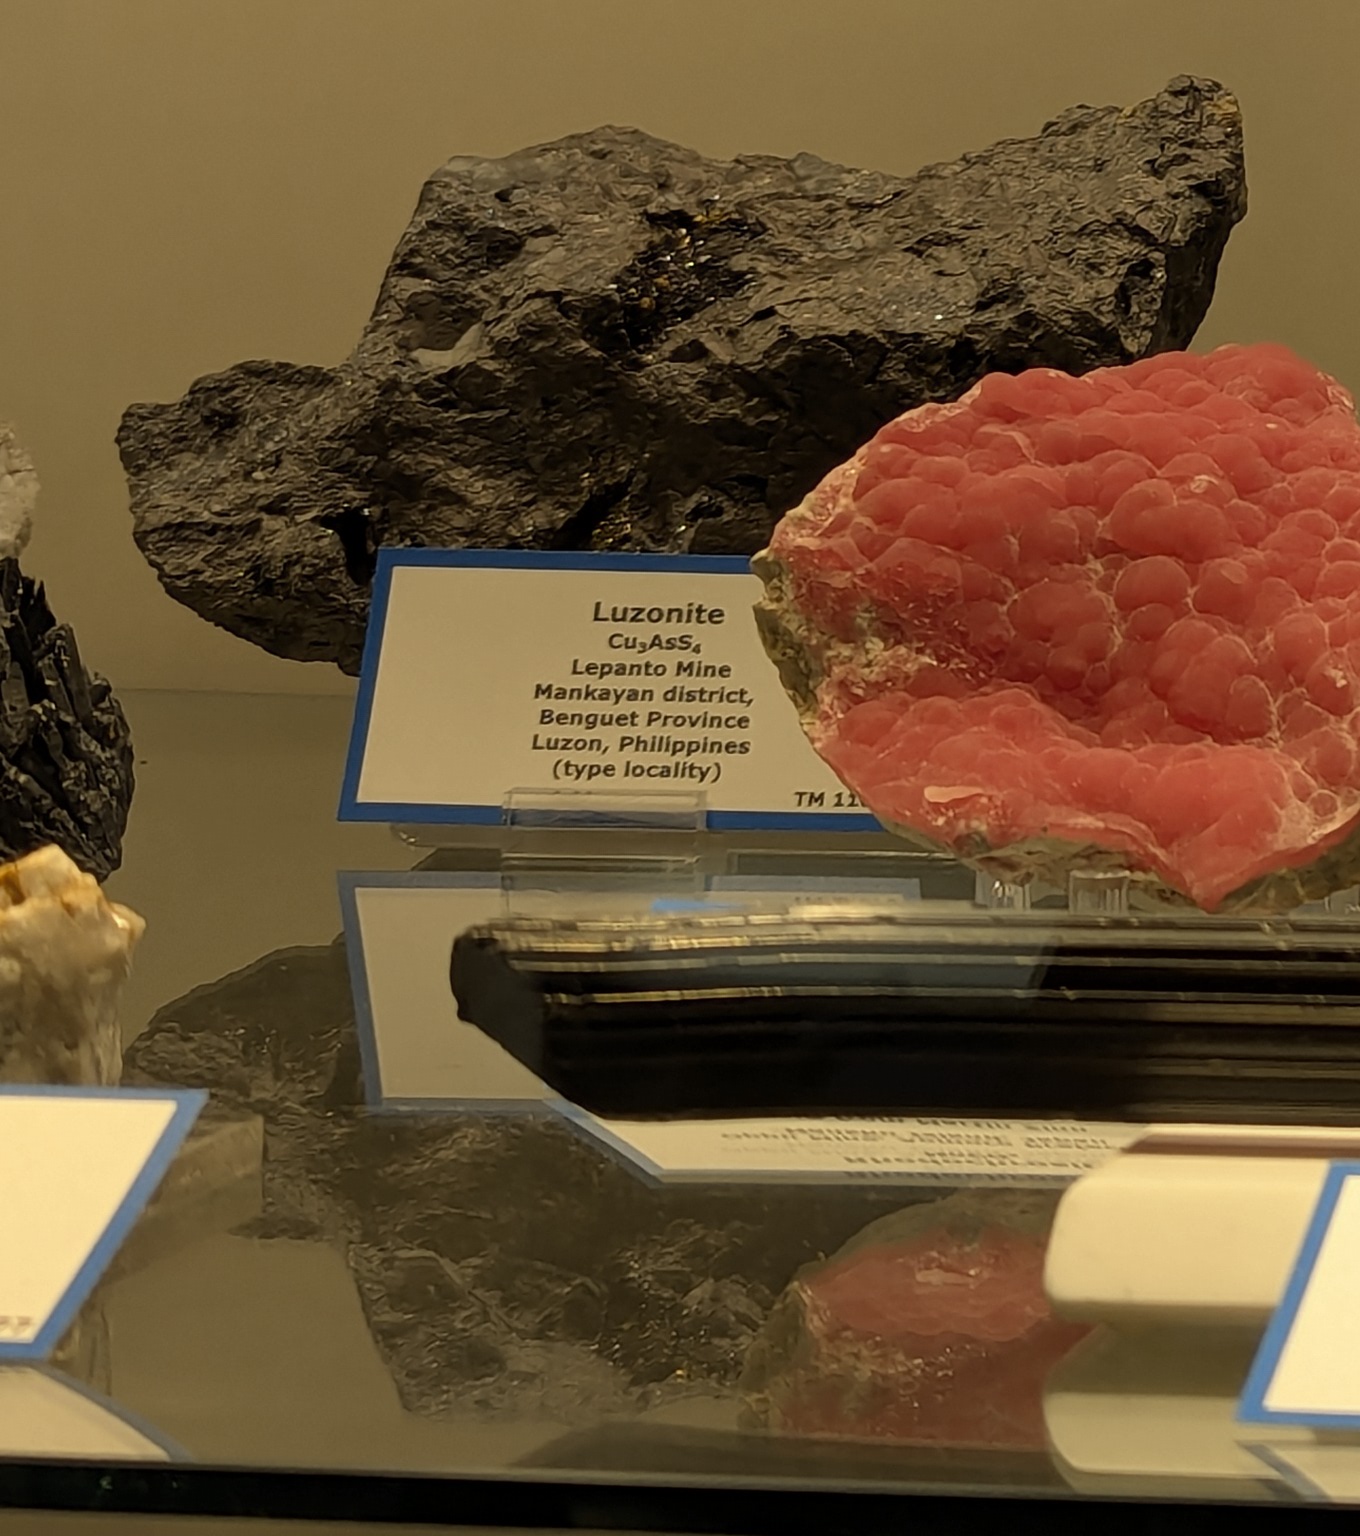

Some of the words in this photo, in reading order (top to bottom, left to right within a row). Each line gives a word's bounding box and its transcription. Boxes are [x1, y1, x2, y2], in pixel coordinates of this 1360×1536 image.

[592, 601, 725, 625] Luzonite
[571, 659, 667, 679] Lepanto
[675, 661, 732, 678] Mine
[533, 683, 654, 705] Mankayan
[662, 685, 755, 707] district,
[539, 708, 639, 730] Benguet
[646, 711, 751, 729] Province
[531, 733, 610, 755] Luzon,
[618, 735, 751, 757] Philippines
[552, 759, 616, 781] (type
[623, 760, 722, 784] locality)
[793, 791, 826, 807] TM
